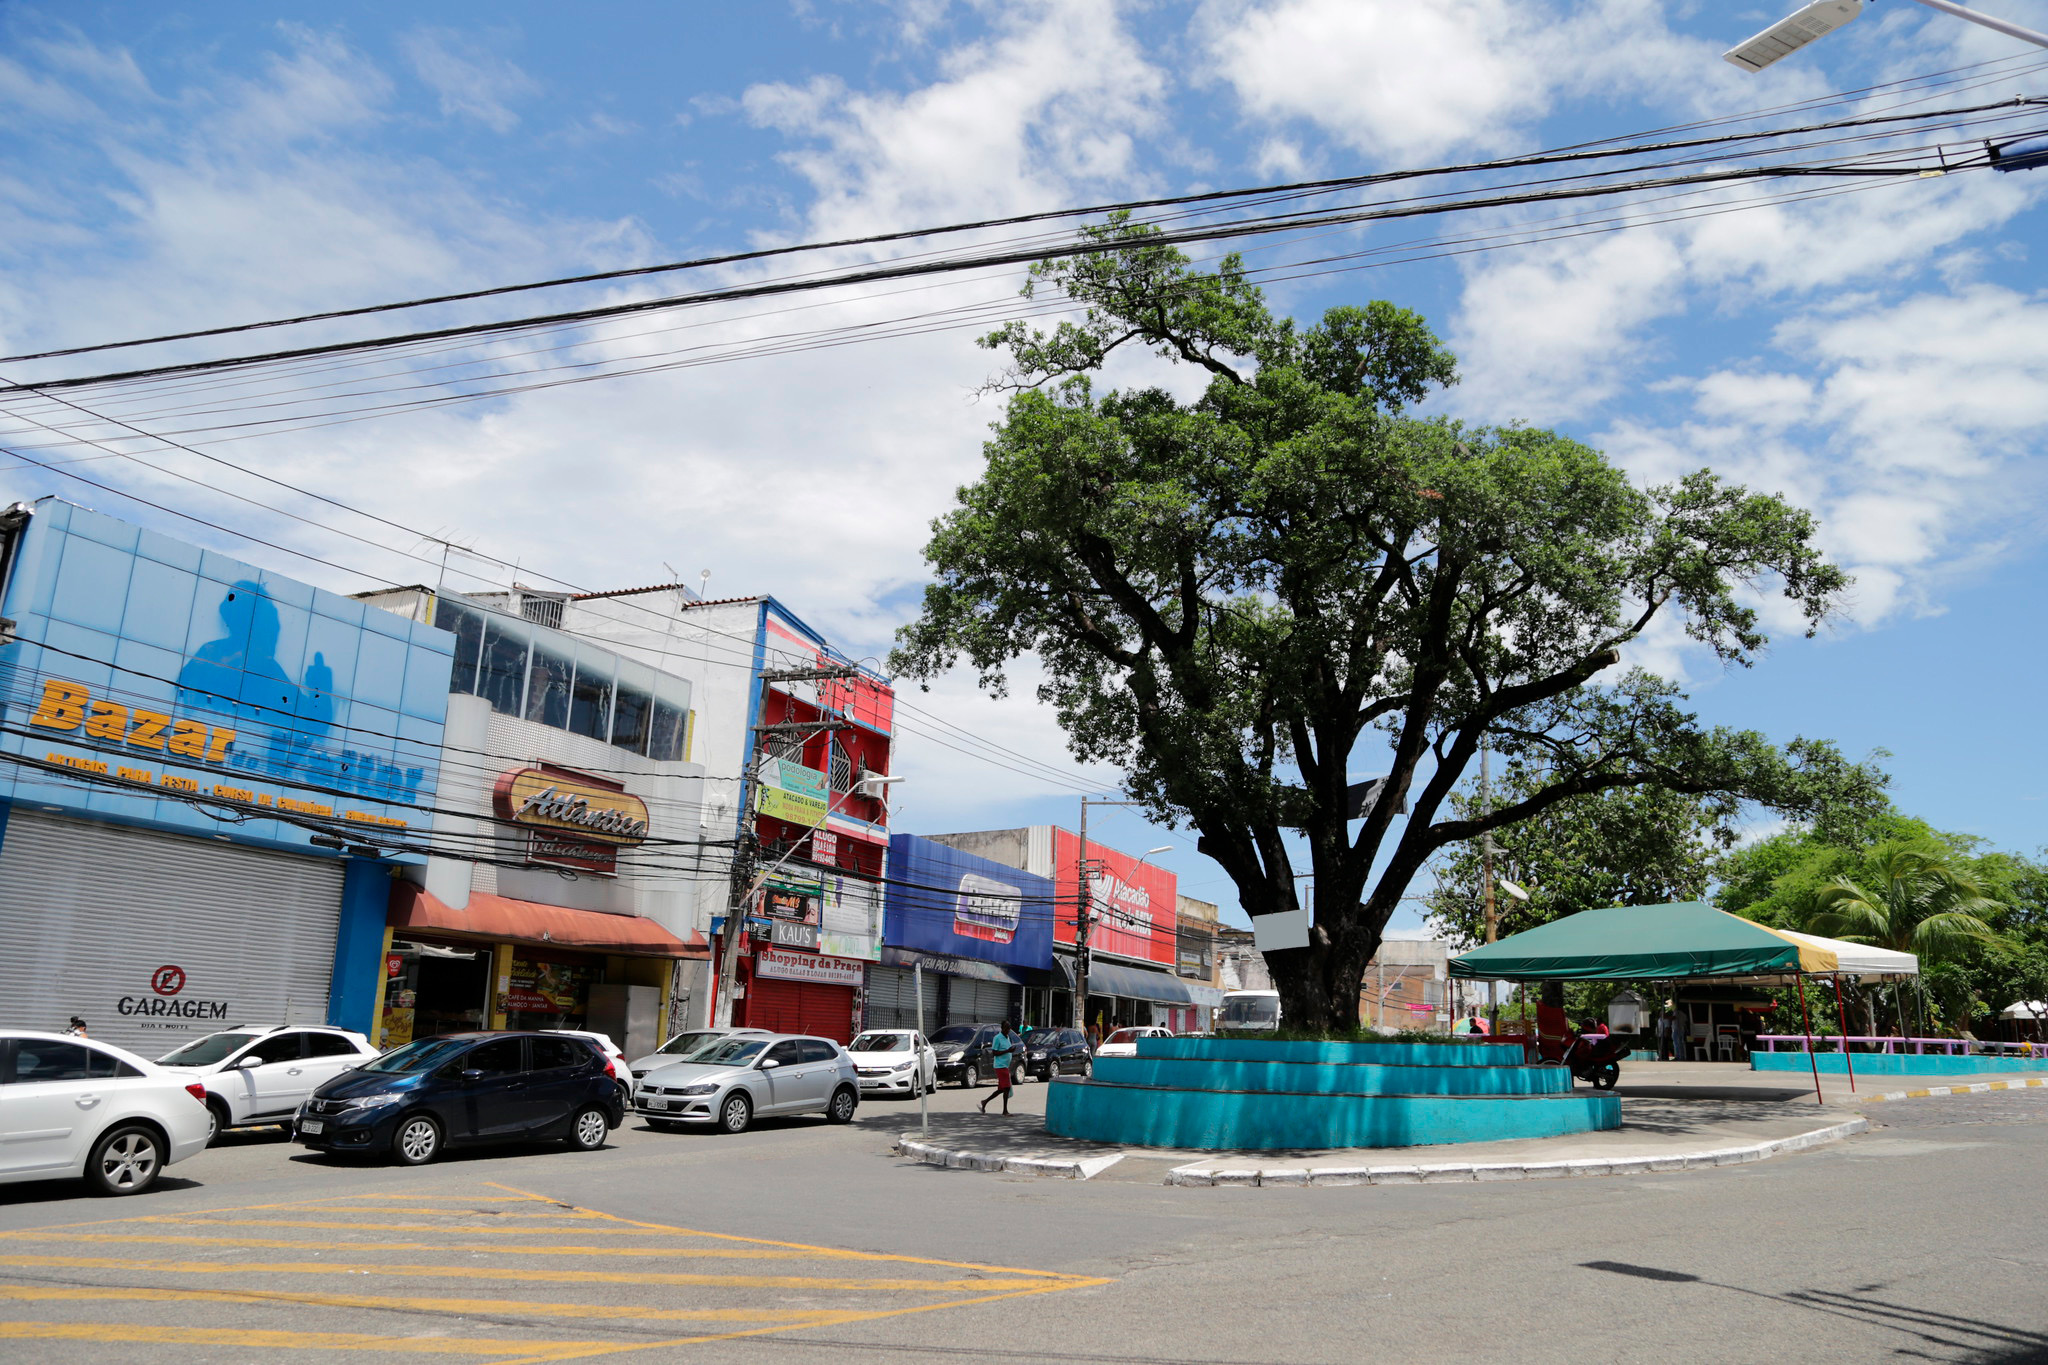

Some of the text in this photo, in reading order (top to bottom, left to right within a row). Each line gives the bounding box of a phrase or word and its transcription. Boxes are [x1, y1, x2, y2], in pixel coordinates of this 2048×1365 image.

[30, 680, 237, 762] Bazar
[46, 752, 108, 774] ARTIGOS
[117, 765, 152, 784] PARA
[161, 773, 198, 792] FESTA
[214, 784, 254, 803] CURSO
[258, 793, 273, 806] DE
[782, 763, 817, 780] podologia
[512, 786, 647, 834] Atlântica
[783, 792, 804, 805] ATACADO
[810, 801, 826, 811] VAREJO
[813, 830, 837, 843] ALUGO
[1113, 879, 1150, 907] Atacadão
[779, 925, 811, 944] KAU'S
[762, 950, 862, 973] Shopping da Praça
[770, 966, 788, 974] ALUGO
[921, 957, 935, 969] VEM
[934, 959, 949, 971] PRO
[118, 996, 228, 1019] GARAGEM
